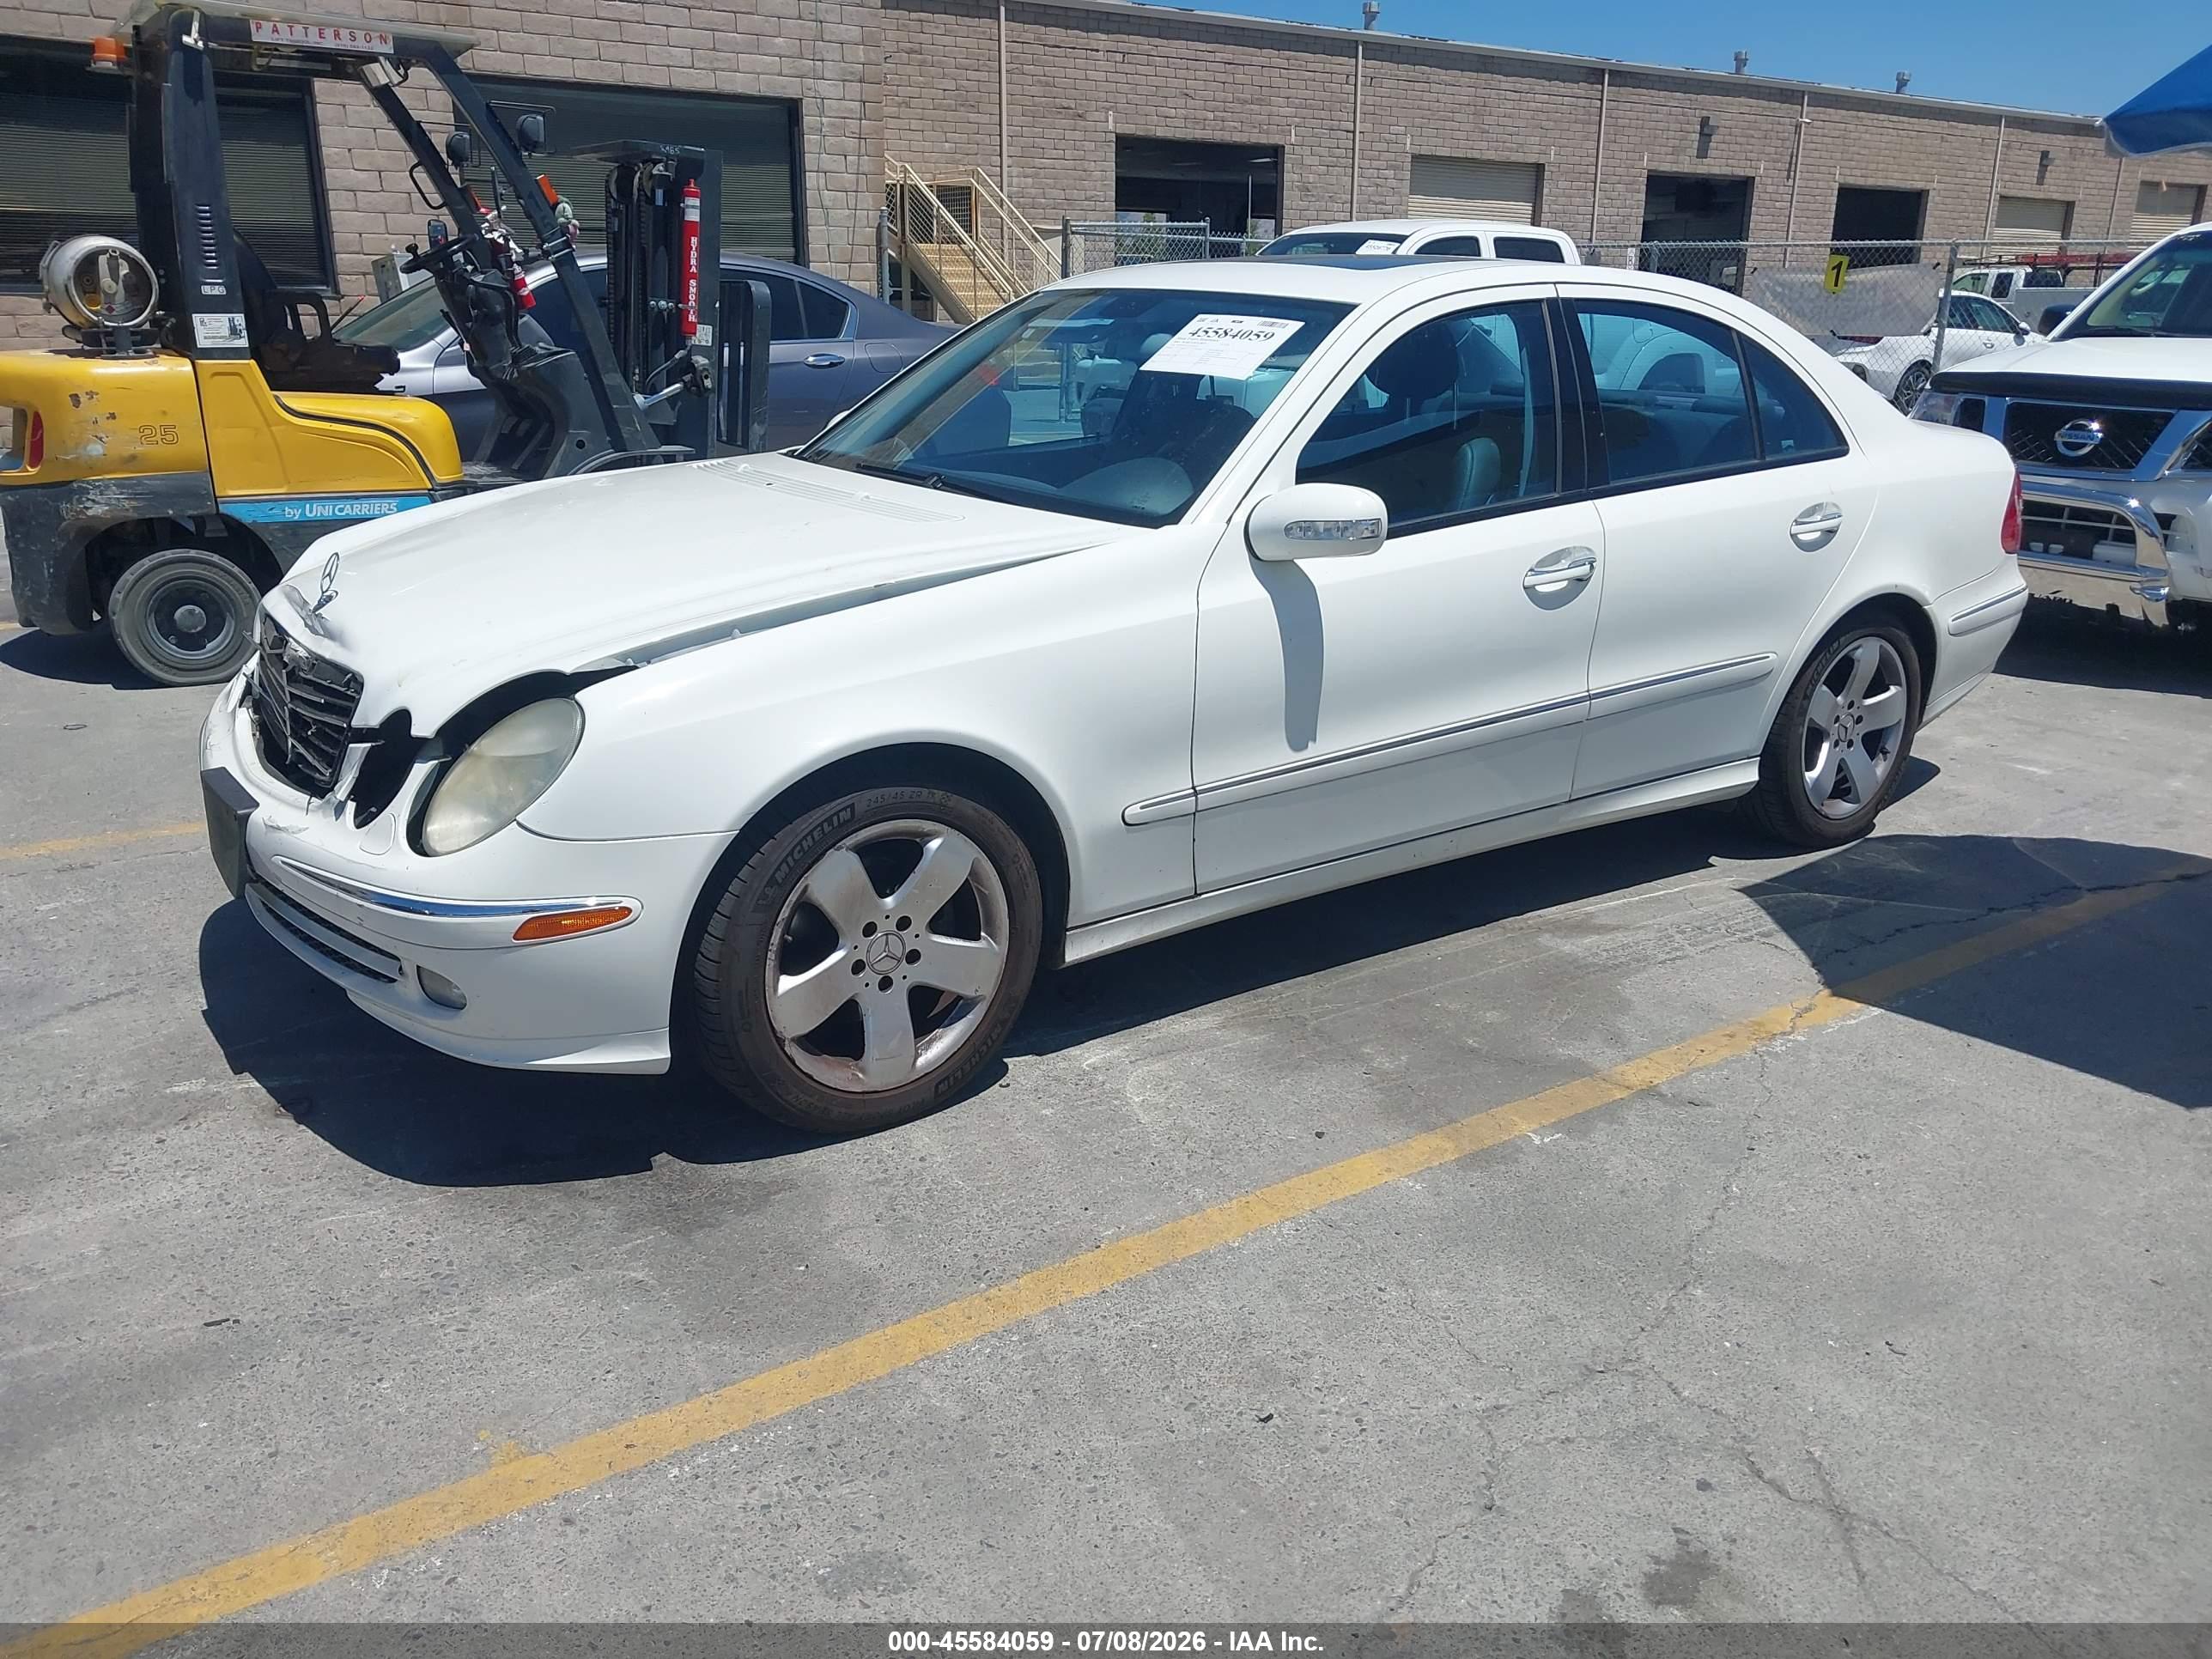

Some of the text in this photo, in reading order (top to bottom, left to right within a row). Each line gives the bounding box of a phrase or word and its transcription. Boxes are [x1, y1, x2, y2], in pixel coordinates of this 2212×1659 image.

[255, 21, 388, 45] PATTERSON
[1832, 261, 1844, 287] 1
[203, 285, 224, 294] LPG
[688, 279, 697, 322] SMOOTH
[1188, 326, 1276, 343] 45584059
[138, 424, 179, 446] 25
[2057, 430, 2101, 442] NISSAN
[285, 507, 301, 519] by
[775, 807, 852, 884] MICHELIN
